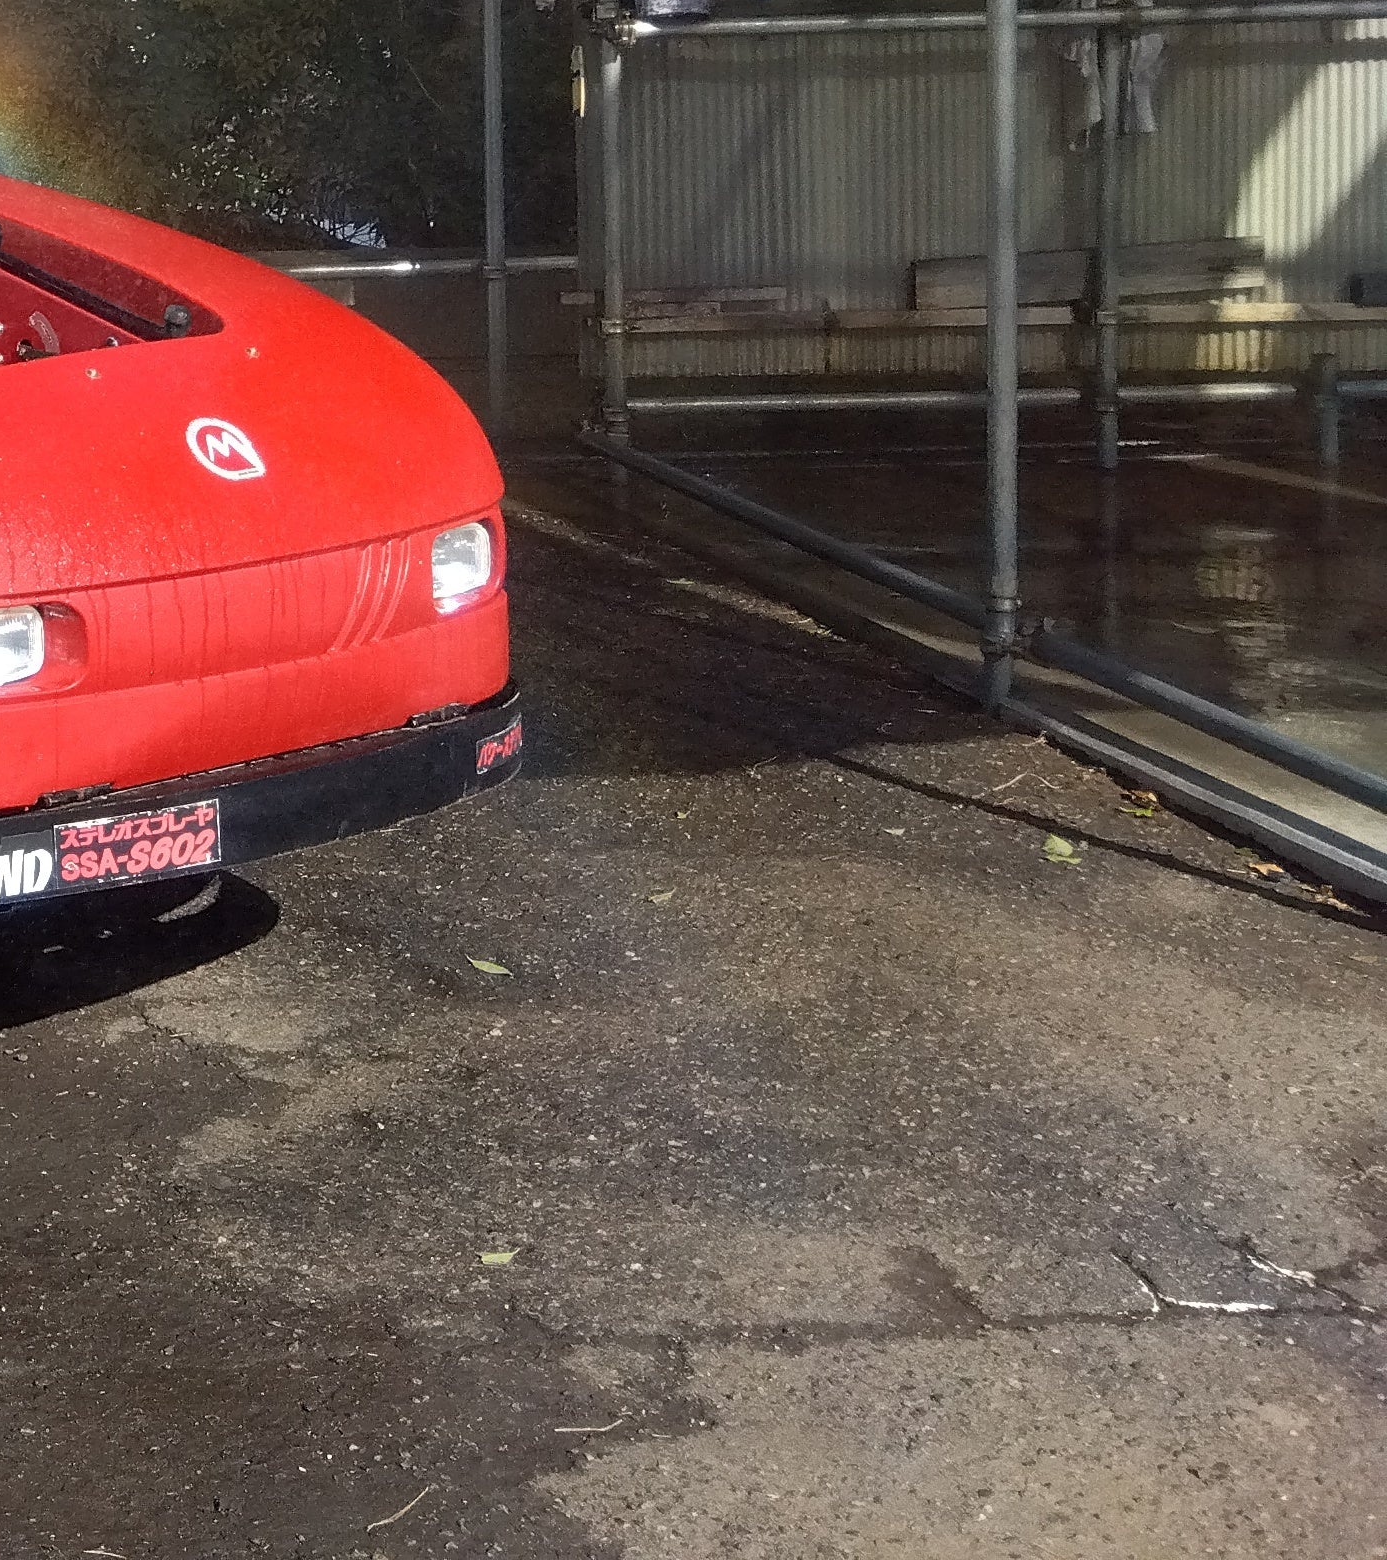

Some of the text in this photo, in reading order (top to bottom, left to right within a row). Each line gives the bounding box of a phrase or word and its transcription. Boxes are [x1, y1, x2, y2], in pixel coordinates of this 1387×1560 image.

[60, 807, 215, 849] ステレオスプレーヤ
[62, 828, 216, 881] SSA-S602
